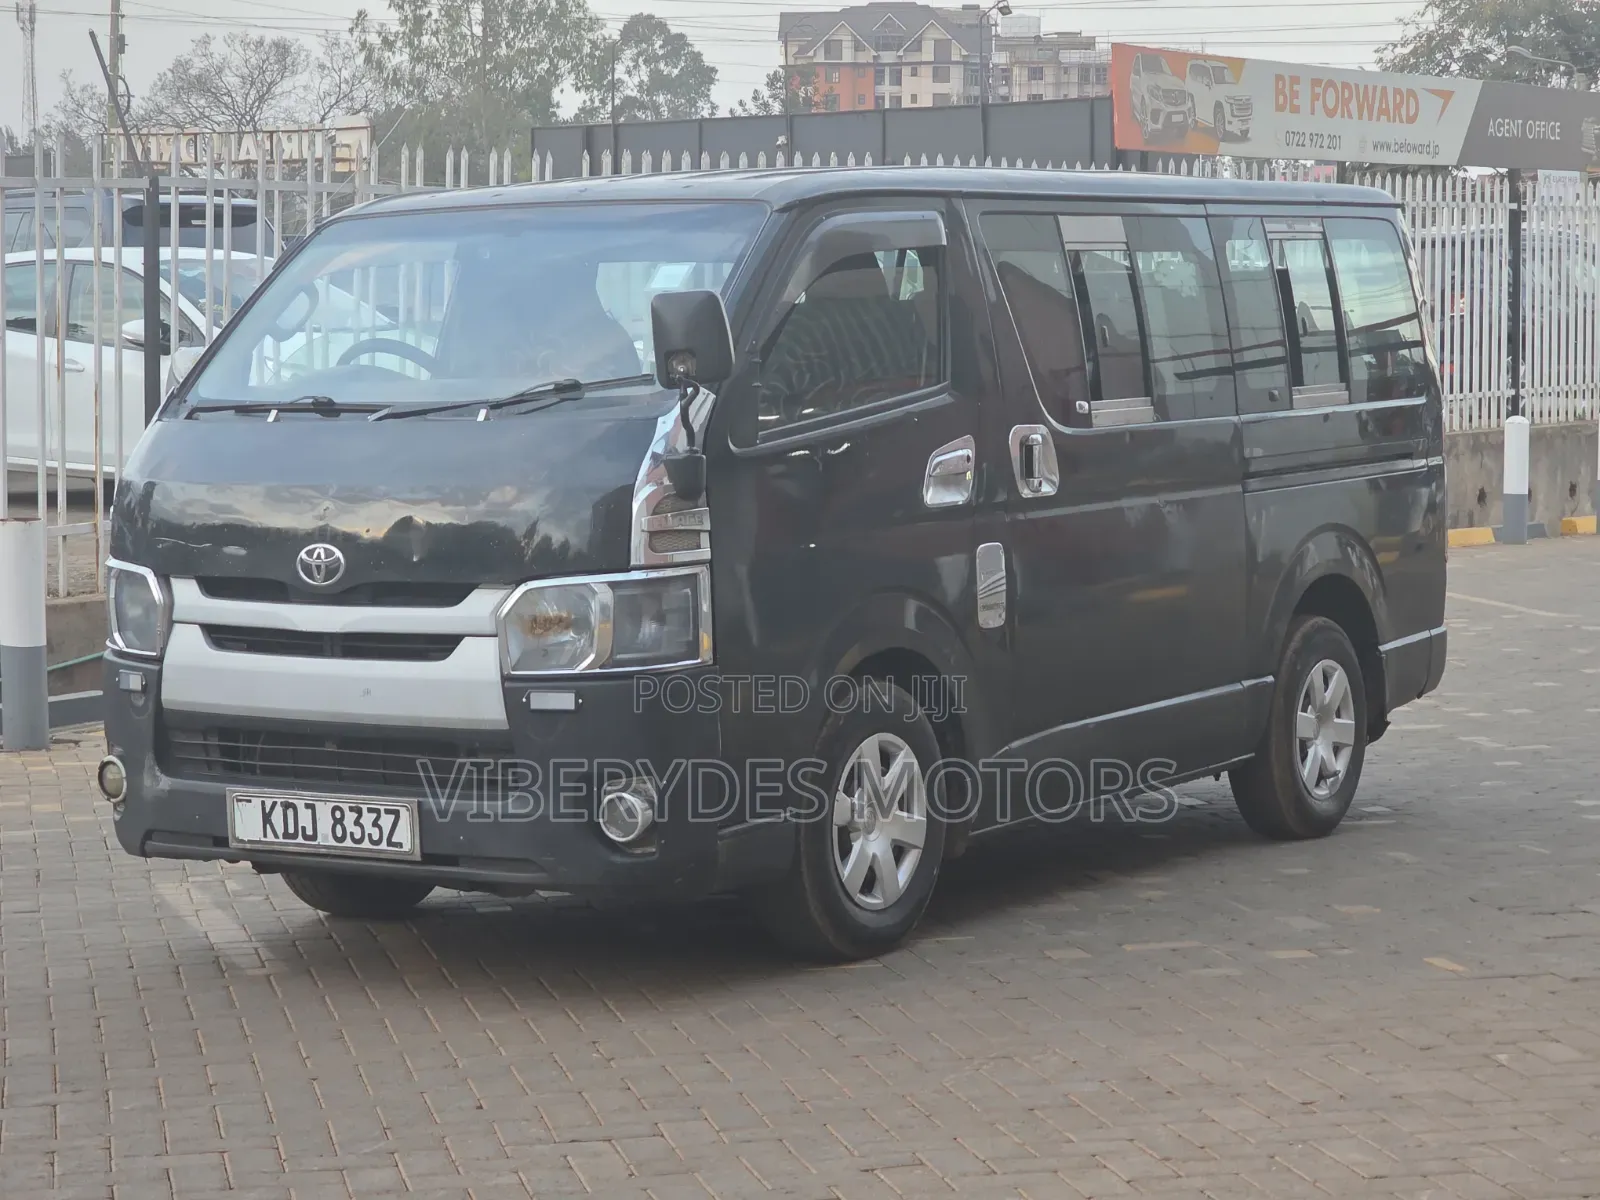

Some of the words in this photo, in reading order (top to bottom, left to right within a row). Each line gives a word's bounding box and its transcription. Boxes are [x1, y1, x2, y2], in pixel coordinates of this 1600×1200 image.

[1274, 73, 1301, 114] BE
[1310, 77, 1420, 124] FORWARD
[1285, 130, 1306, 148] 0722
[1309, 132, 1325, 149] 972
[1327, 134, 1342, 151] 201
[1487, 117, 1523, 138] AGENT
[1526, 120, 1561, 140] OFFICE
[260, 799, 319, 842] KDJ
[330, 804, 404, 850] 833Z
